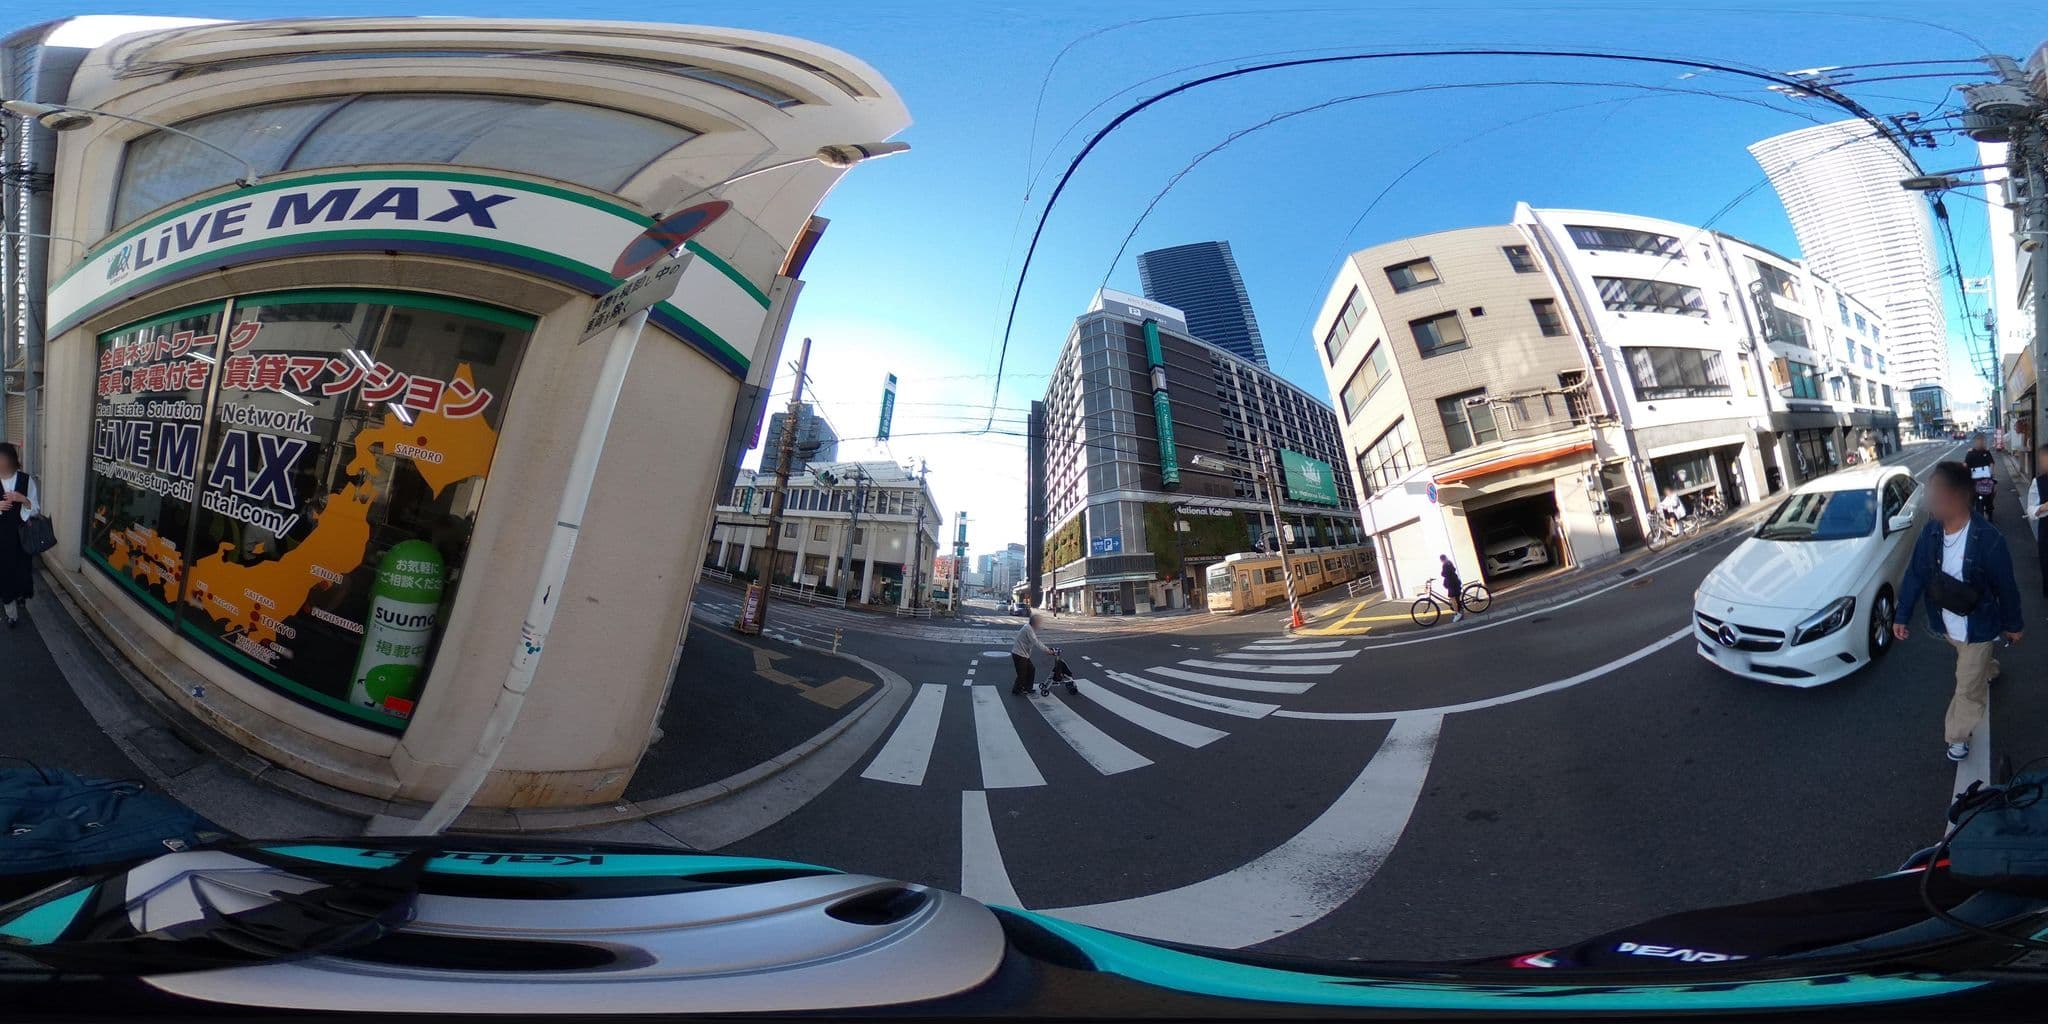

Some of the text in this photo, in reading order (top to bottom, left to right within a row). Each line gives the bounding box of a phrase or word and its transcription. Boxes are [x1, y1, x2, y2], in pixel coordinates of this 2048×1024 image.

[266, 186, 517, 230] MAX
[100, 321, 263, 371] 全国ネットワーク
[96, 401, 314, 434] Real Estate Solution Network
[395, 444, 443, 464] SAPPORO
[310, 564, 343, 585] SENDAI
[396, 560, 439, 574] お気軽に
[260, 613, 296, 640] TOKYO
[311, 608, 364, 634] FUKUSHIMA
[376, 639, 425, 659] 掲載中
